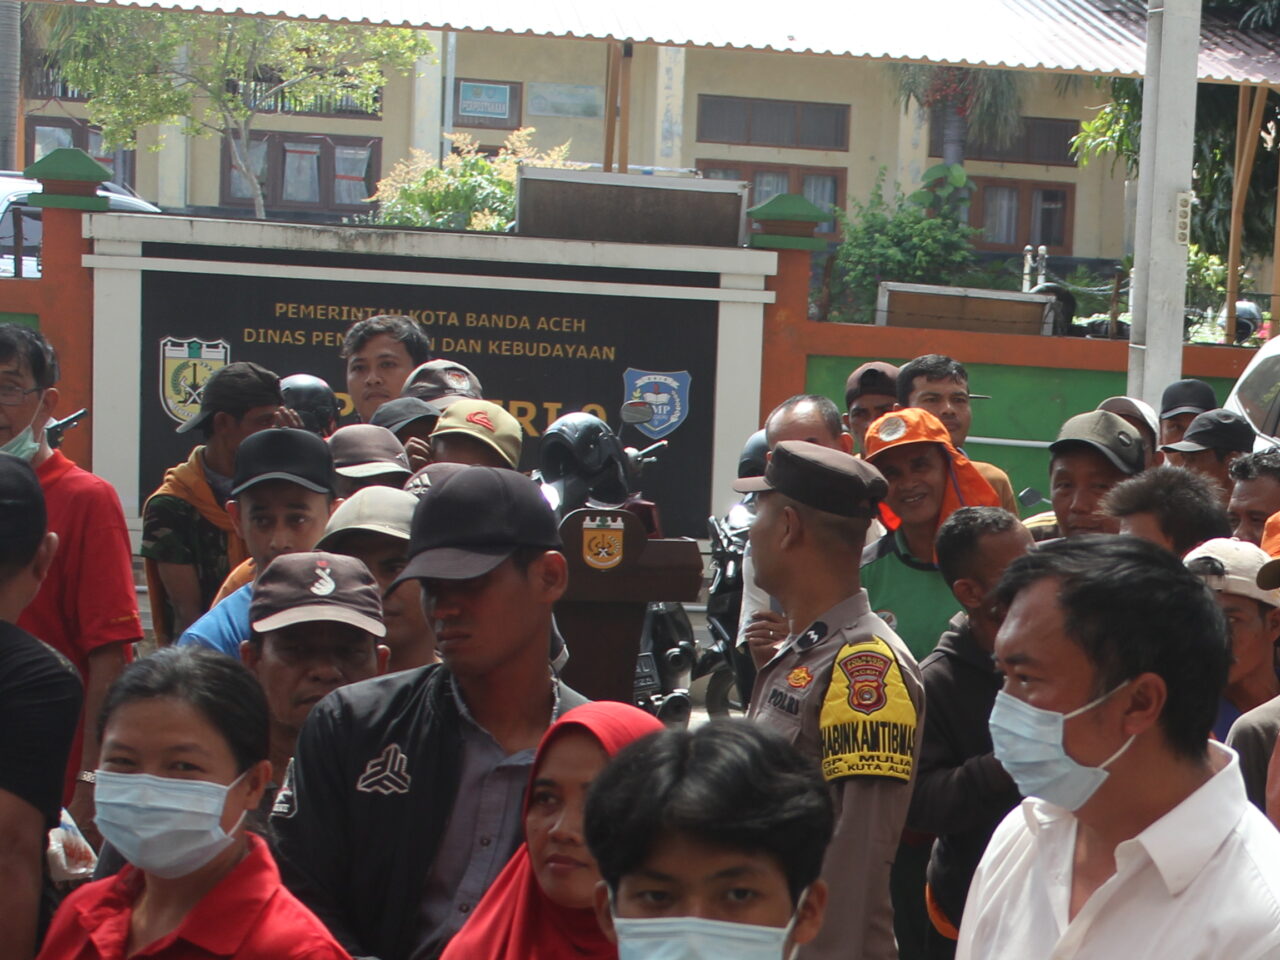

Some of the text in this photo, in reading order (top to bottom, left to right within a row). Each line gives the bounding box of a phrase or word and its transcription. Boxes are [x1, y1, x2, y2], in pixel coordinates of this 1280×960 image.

[408, 310, 460, 326] KOTA
[466, 313, 531, 330] BANDA
[536, 316, 586, 333] ACEH
[243, 328, 306, 345] DINAS
[442, 337, 482, 353] DAN
[488, 340, 615, 361] KEBUDAYAAN
[768, 688, 799, 715] POLRI
[848, 764, 883, 772] KUTA
[859, 755, 911, 767] MULIA
